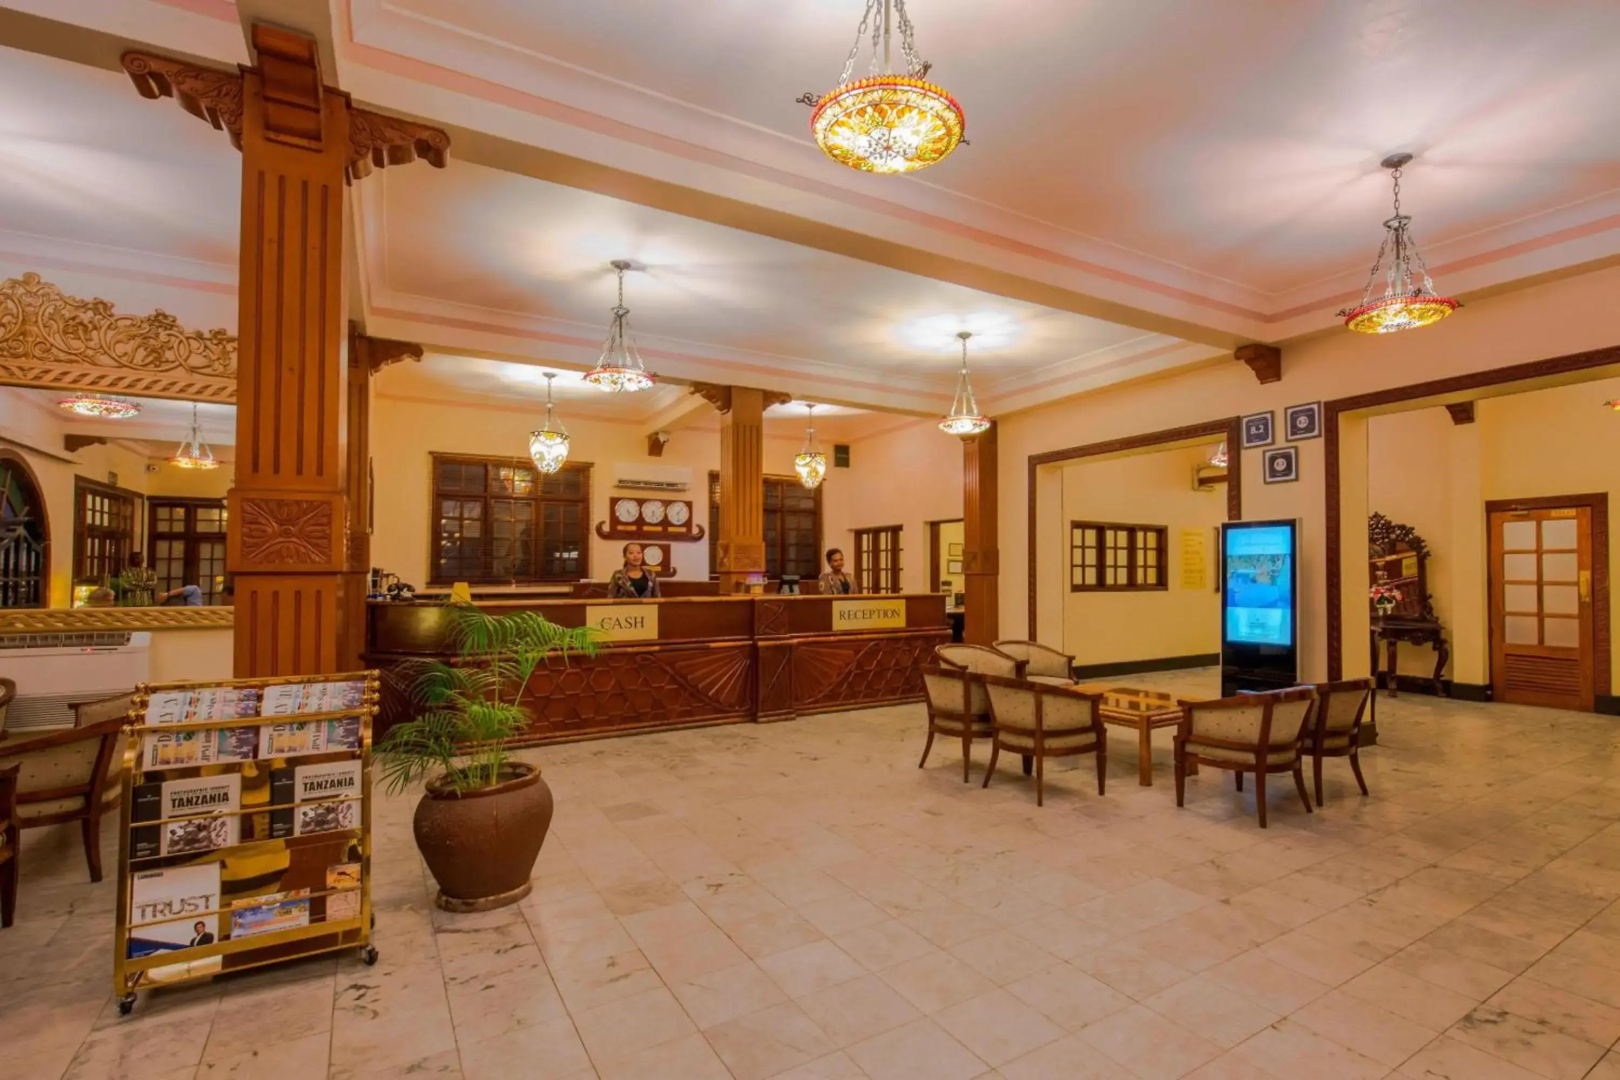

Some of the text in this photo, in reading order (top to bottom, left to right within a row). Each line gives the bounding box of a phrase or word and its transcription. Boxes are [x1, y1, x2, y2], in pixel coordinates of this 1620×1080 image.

[839, 608, 900, 621] RECEPTION
[600, 616, 645, 630] CASH
[303, 777, 355, 793] TANZANIA
[171, 792, 230, 809] TANZANIA
[135, 893, 216, 920] TRUST
